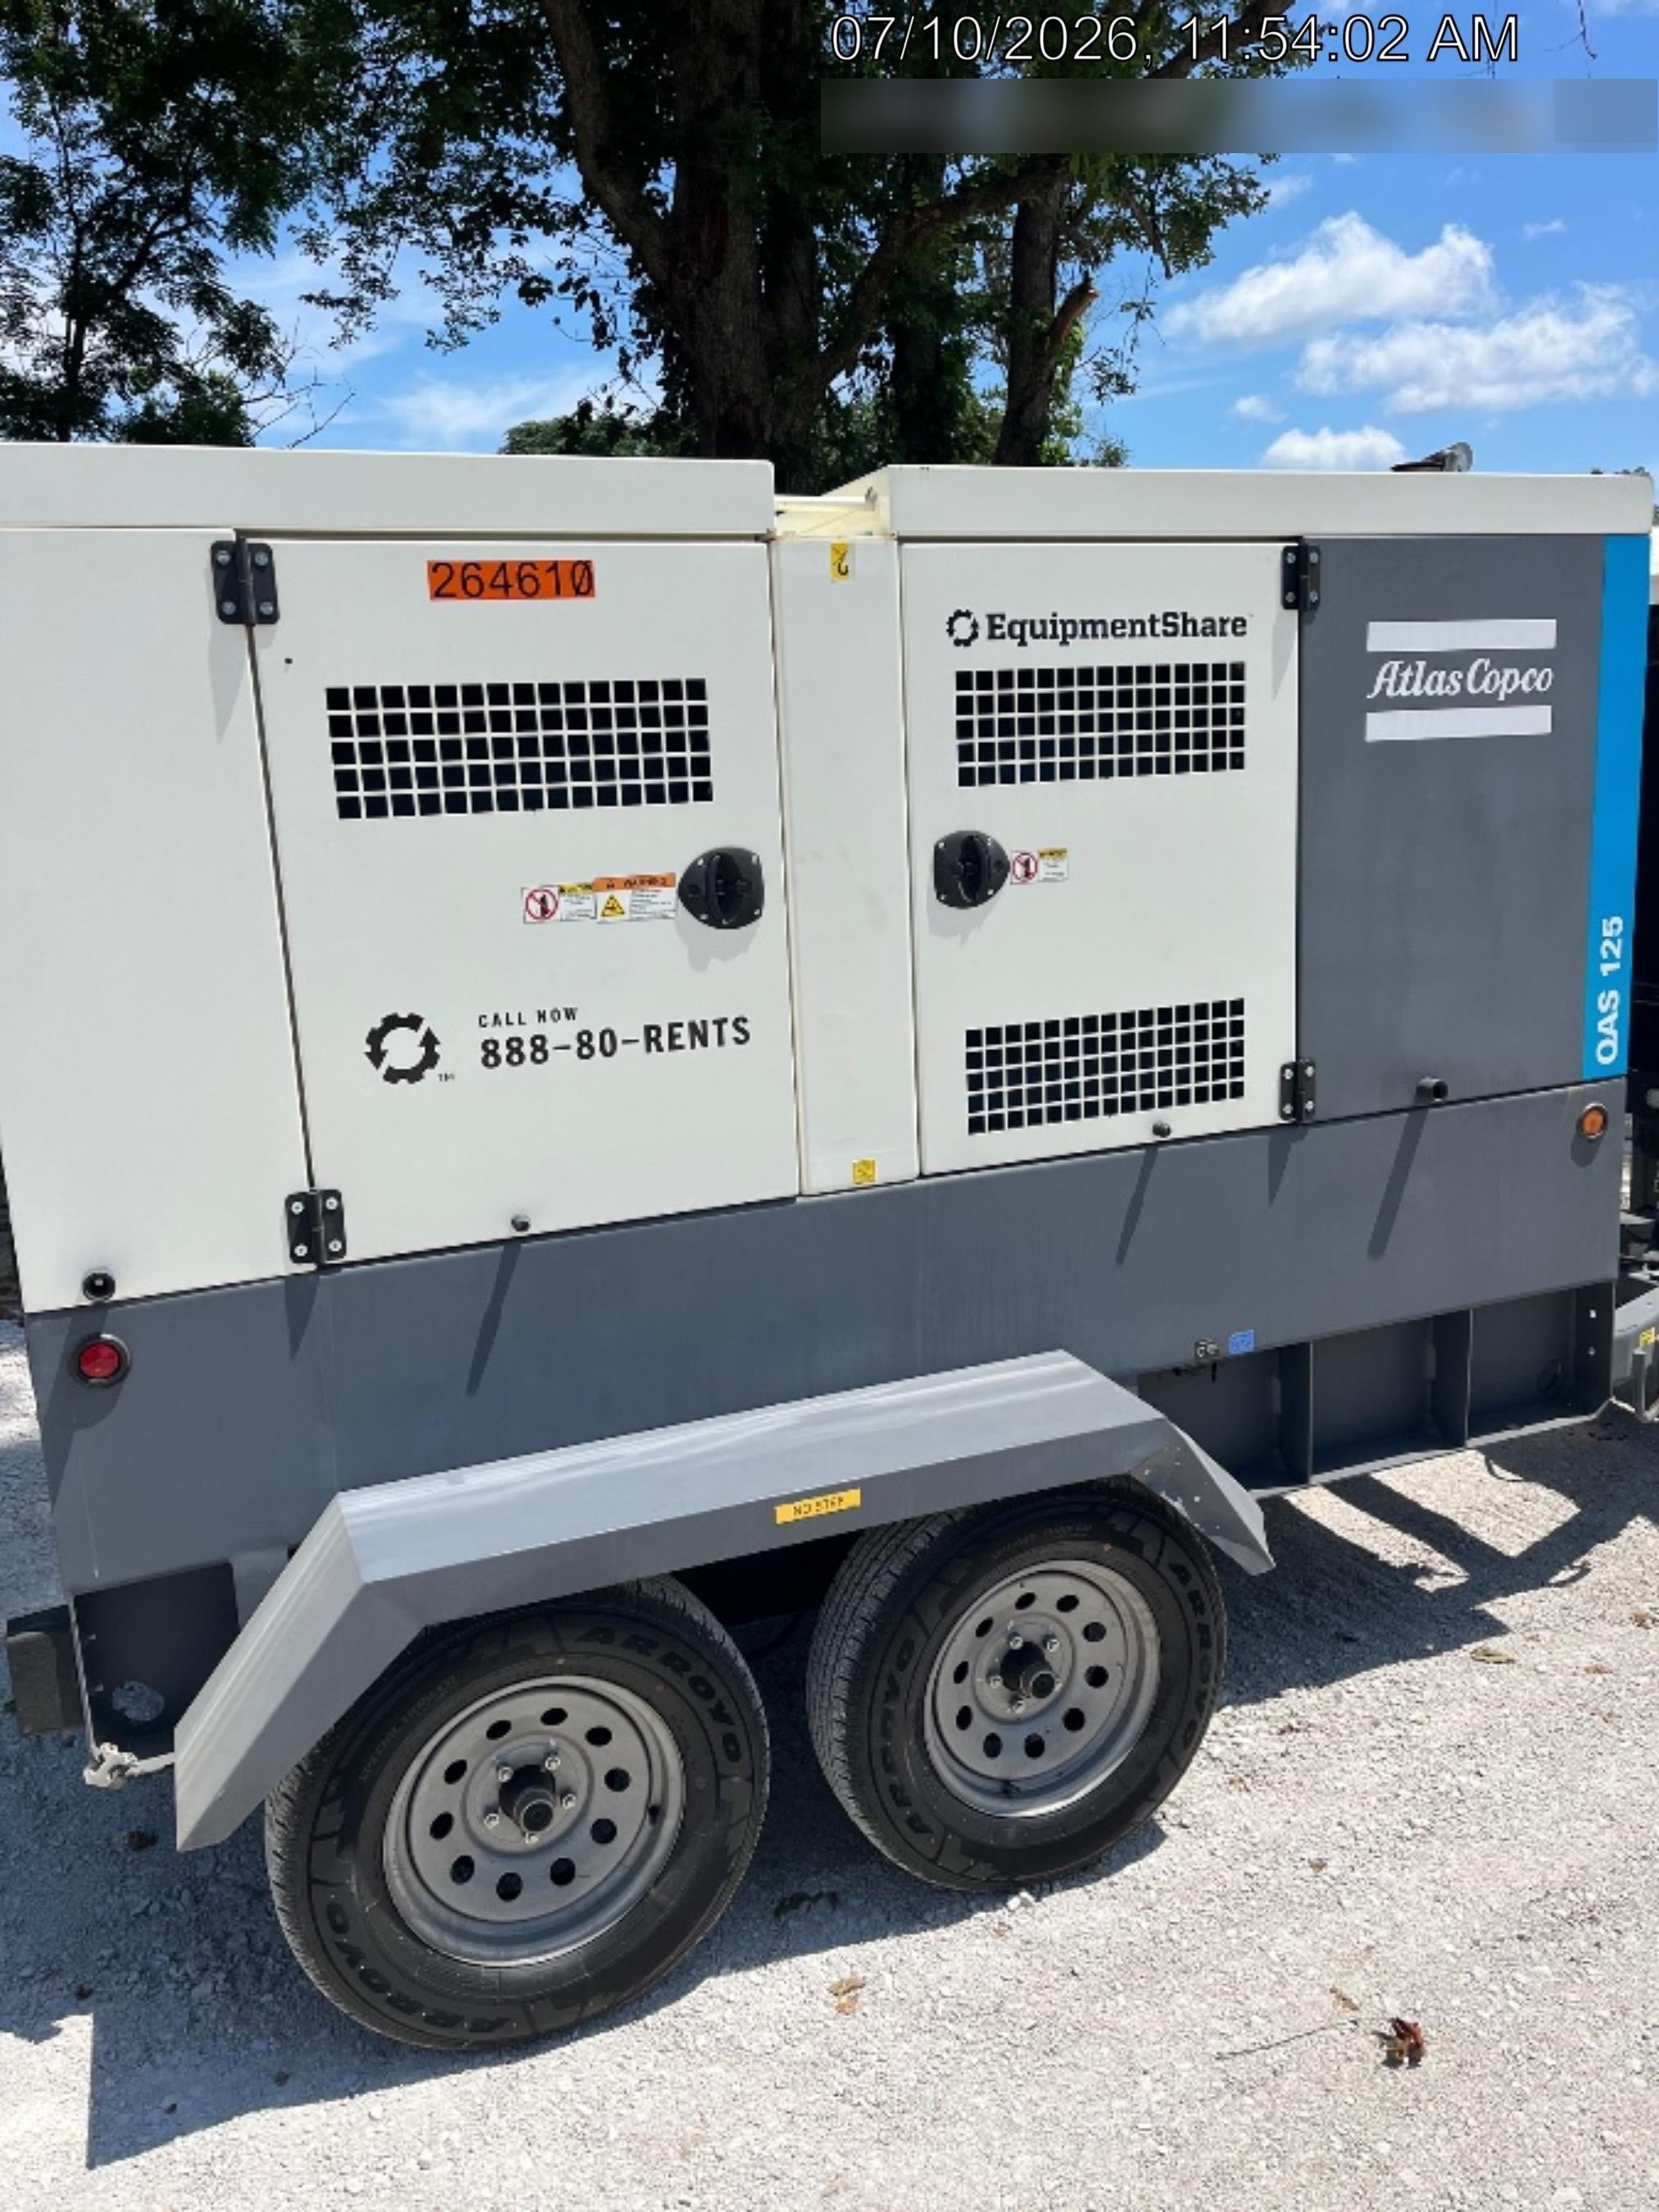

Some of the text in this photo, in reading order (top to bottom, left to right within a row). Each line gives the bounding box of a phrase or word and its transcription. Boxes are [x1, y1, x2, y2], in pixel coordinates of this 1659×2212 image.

[431, 561, 593, 598] 264610
[986, 611, 1248, 648] EquipmentShare
[1366, 658, 1554, 701] Atlas Copco
[1599, 916, 1624, 977] 125
[478, 1007, 578, 1028] CALL NOW
[479, 1015, 751, 1070] 888-80-RENTS
[574, 1626, 741, 1763] ARROYO
